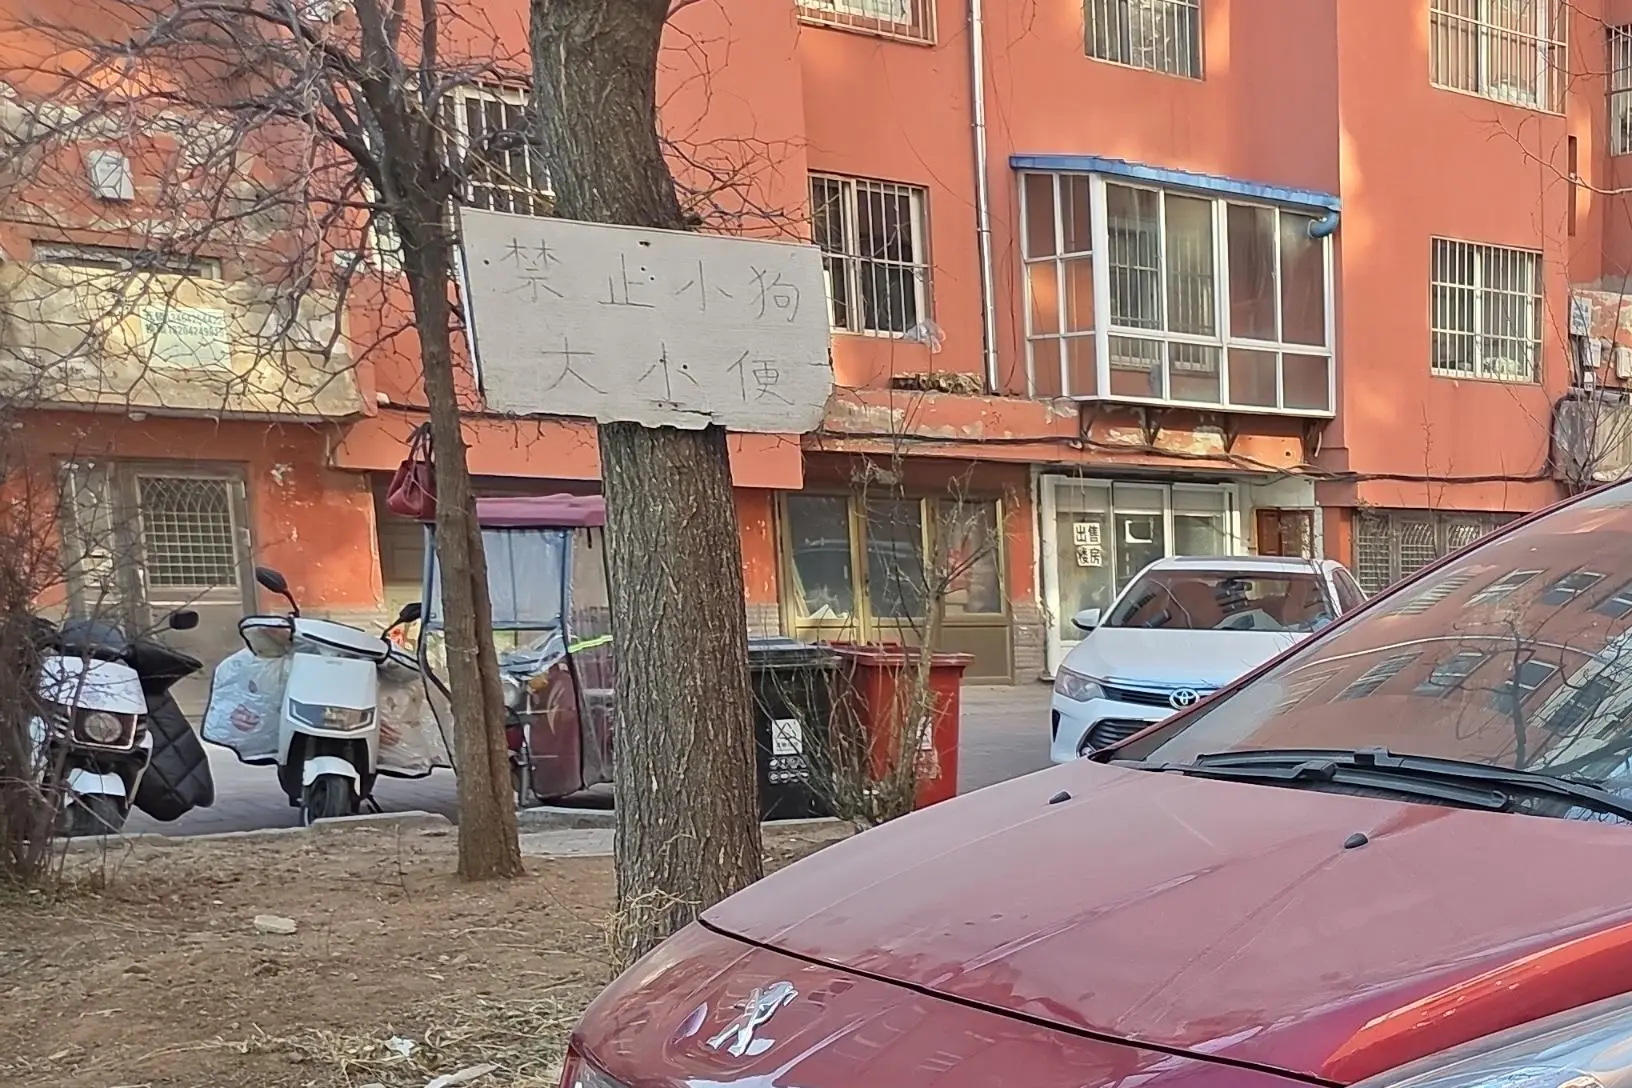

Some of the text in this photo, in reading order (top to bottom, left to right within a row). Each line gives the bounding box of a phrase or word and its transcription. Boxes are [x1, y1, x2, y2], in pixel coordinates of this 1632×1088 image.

[499, 237, 800, 322] 禁止小狗
[541, 336, 795, 406] 大小便
[1075, 524, 1099, 543] 出售
